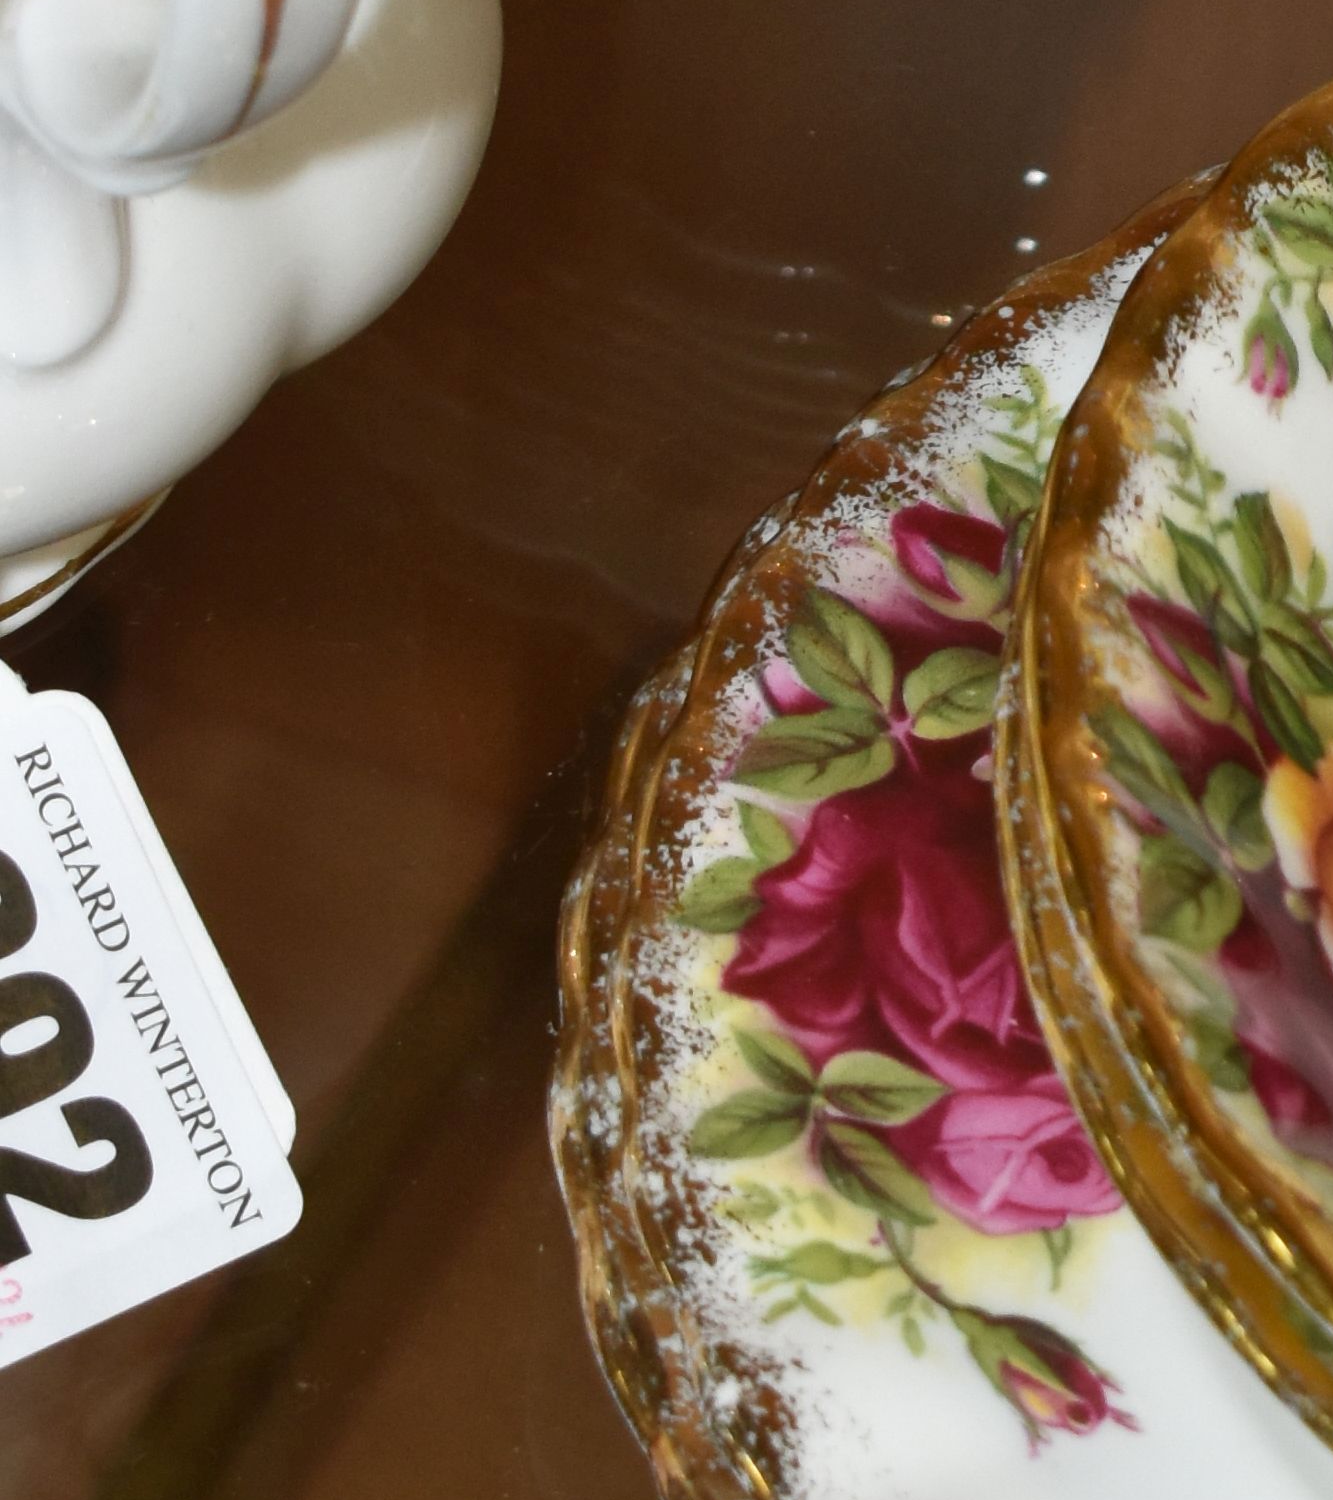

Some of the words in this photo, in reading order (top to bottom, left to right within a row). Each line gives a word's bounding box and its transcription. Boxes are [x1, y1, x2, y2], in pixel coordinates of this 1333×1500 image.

[0, 848, 154, 1266] 92
[14, 741, 131, 954] RICHARD
[116, 955, 263, 1230] WINTERTON
